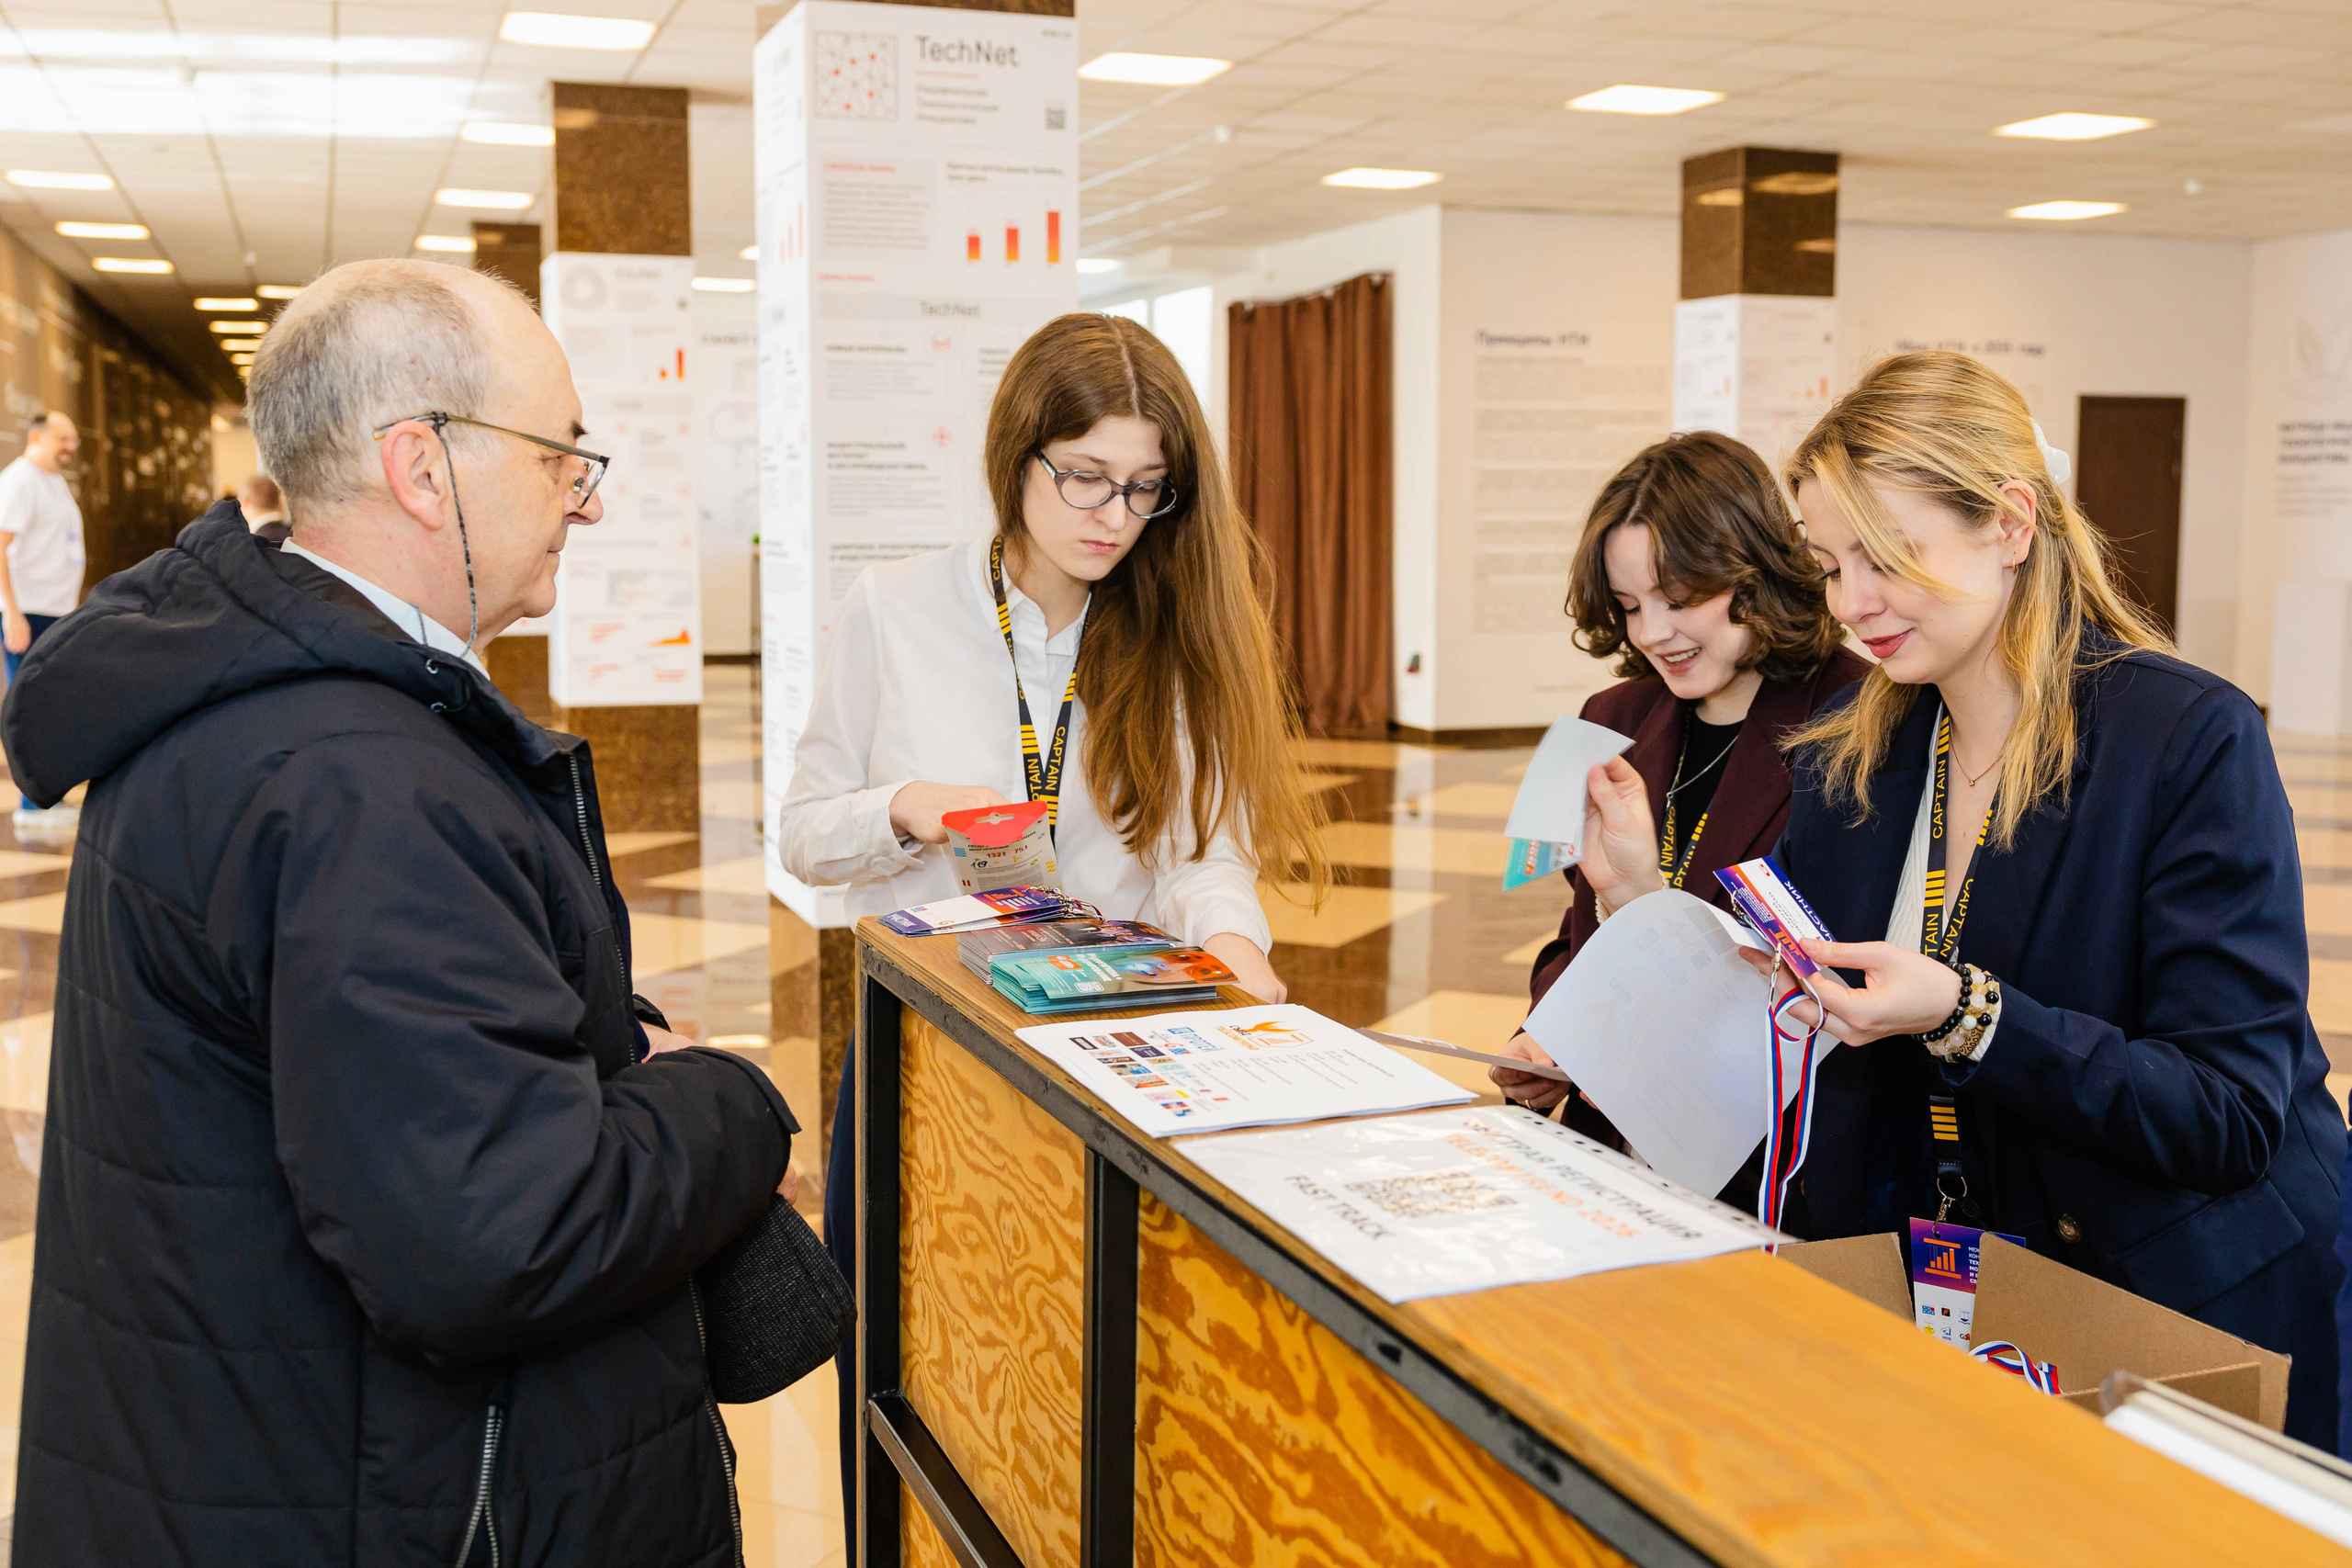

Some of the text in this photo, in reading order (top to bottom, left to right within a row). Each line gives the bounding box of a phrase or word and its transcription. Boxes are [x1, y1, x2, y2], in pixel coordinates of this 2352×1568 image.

[916, 35, 1021, 68] TechNet
[920, 299, 981, 318] TechNet
[1027, 758, 1041, 801] PTAIN
[1046, 726, 1066, 791] CAPTAIN
[1933, 760, 1946, 839] CAPTAIN
[1660, 806, 1676, 867] CAPTAIN
[1784, 881, 1833, 942] ЧАСТНИК
[1924, 913, 1939, 956] TAIN
[1940, 878, 1973, 958] CAPTAIN
[1184, 1028, 1224, 1053] ПРОТЕЙ
[1286, 1174, 1394, 1240] FAST TRACK
